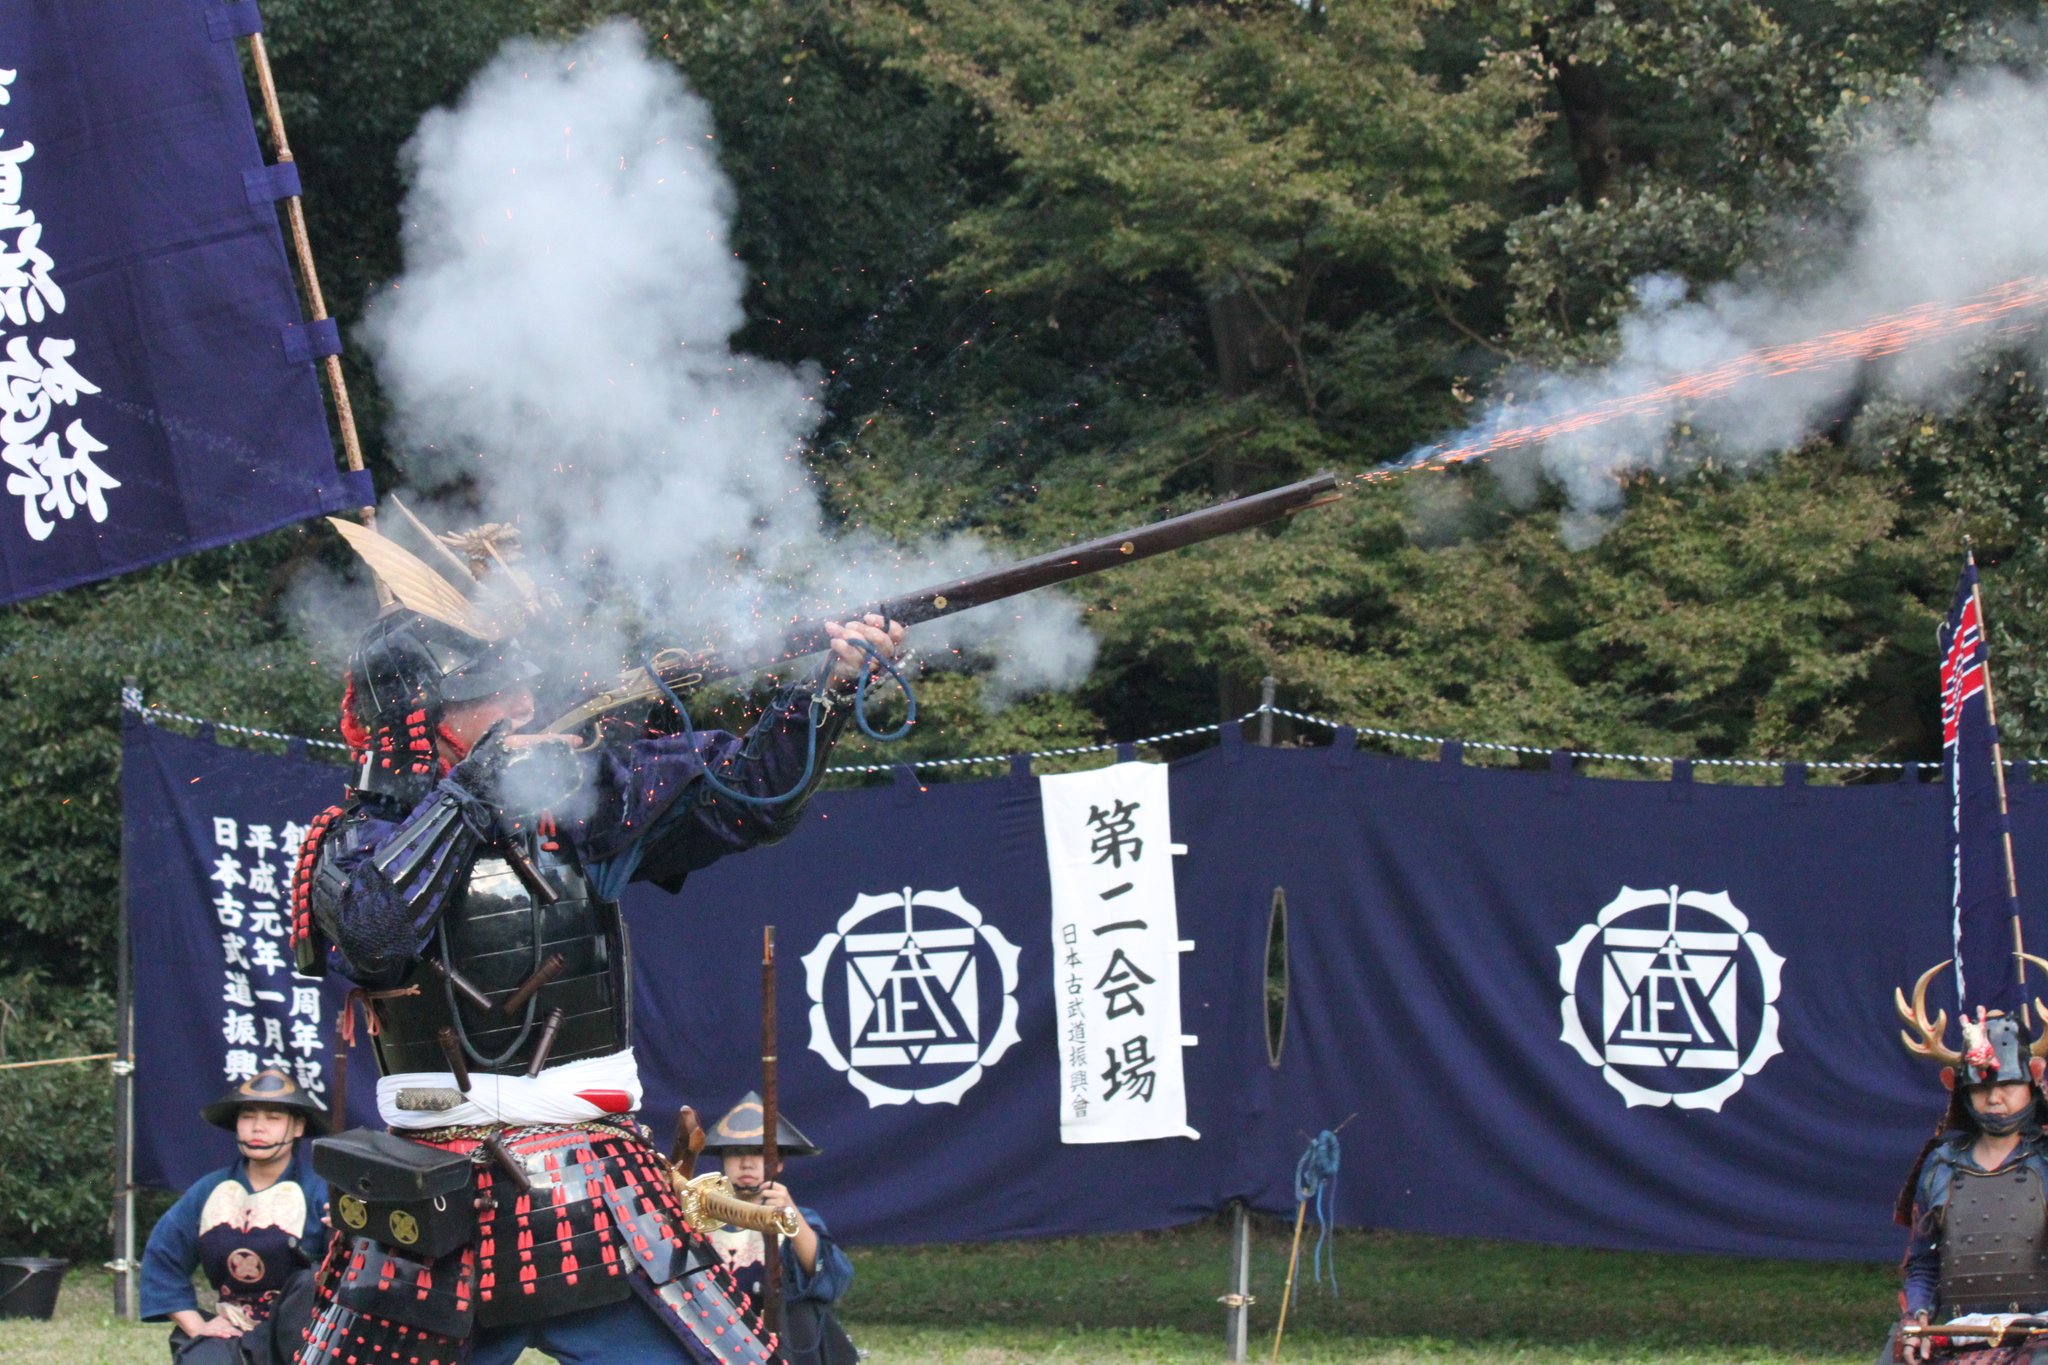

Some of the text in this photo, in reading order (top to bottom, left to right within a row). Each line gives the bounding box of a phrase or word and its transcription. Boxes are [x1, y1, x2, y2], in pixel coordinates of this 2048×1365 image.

[1062, 923, 1090, 1118] 日本古武道振興會
[1084, 798, 1157, 1104] 第二会場
